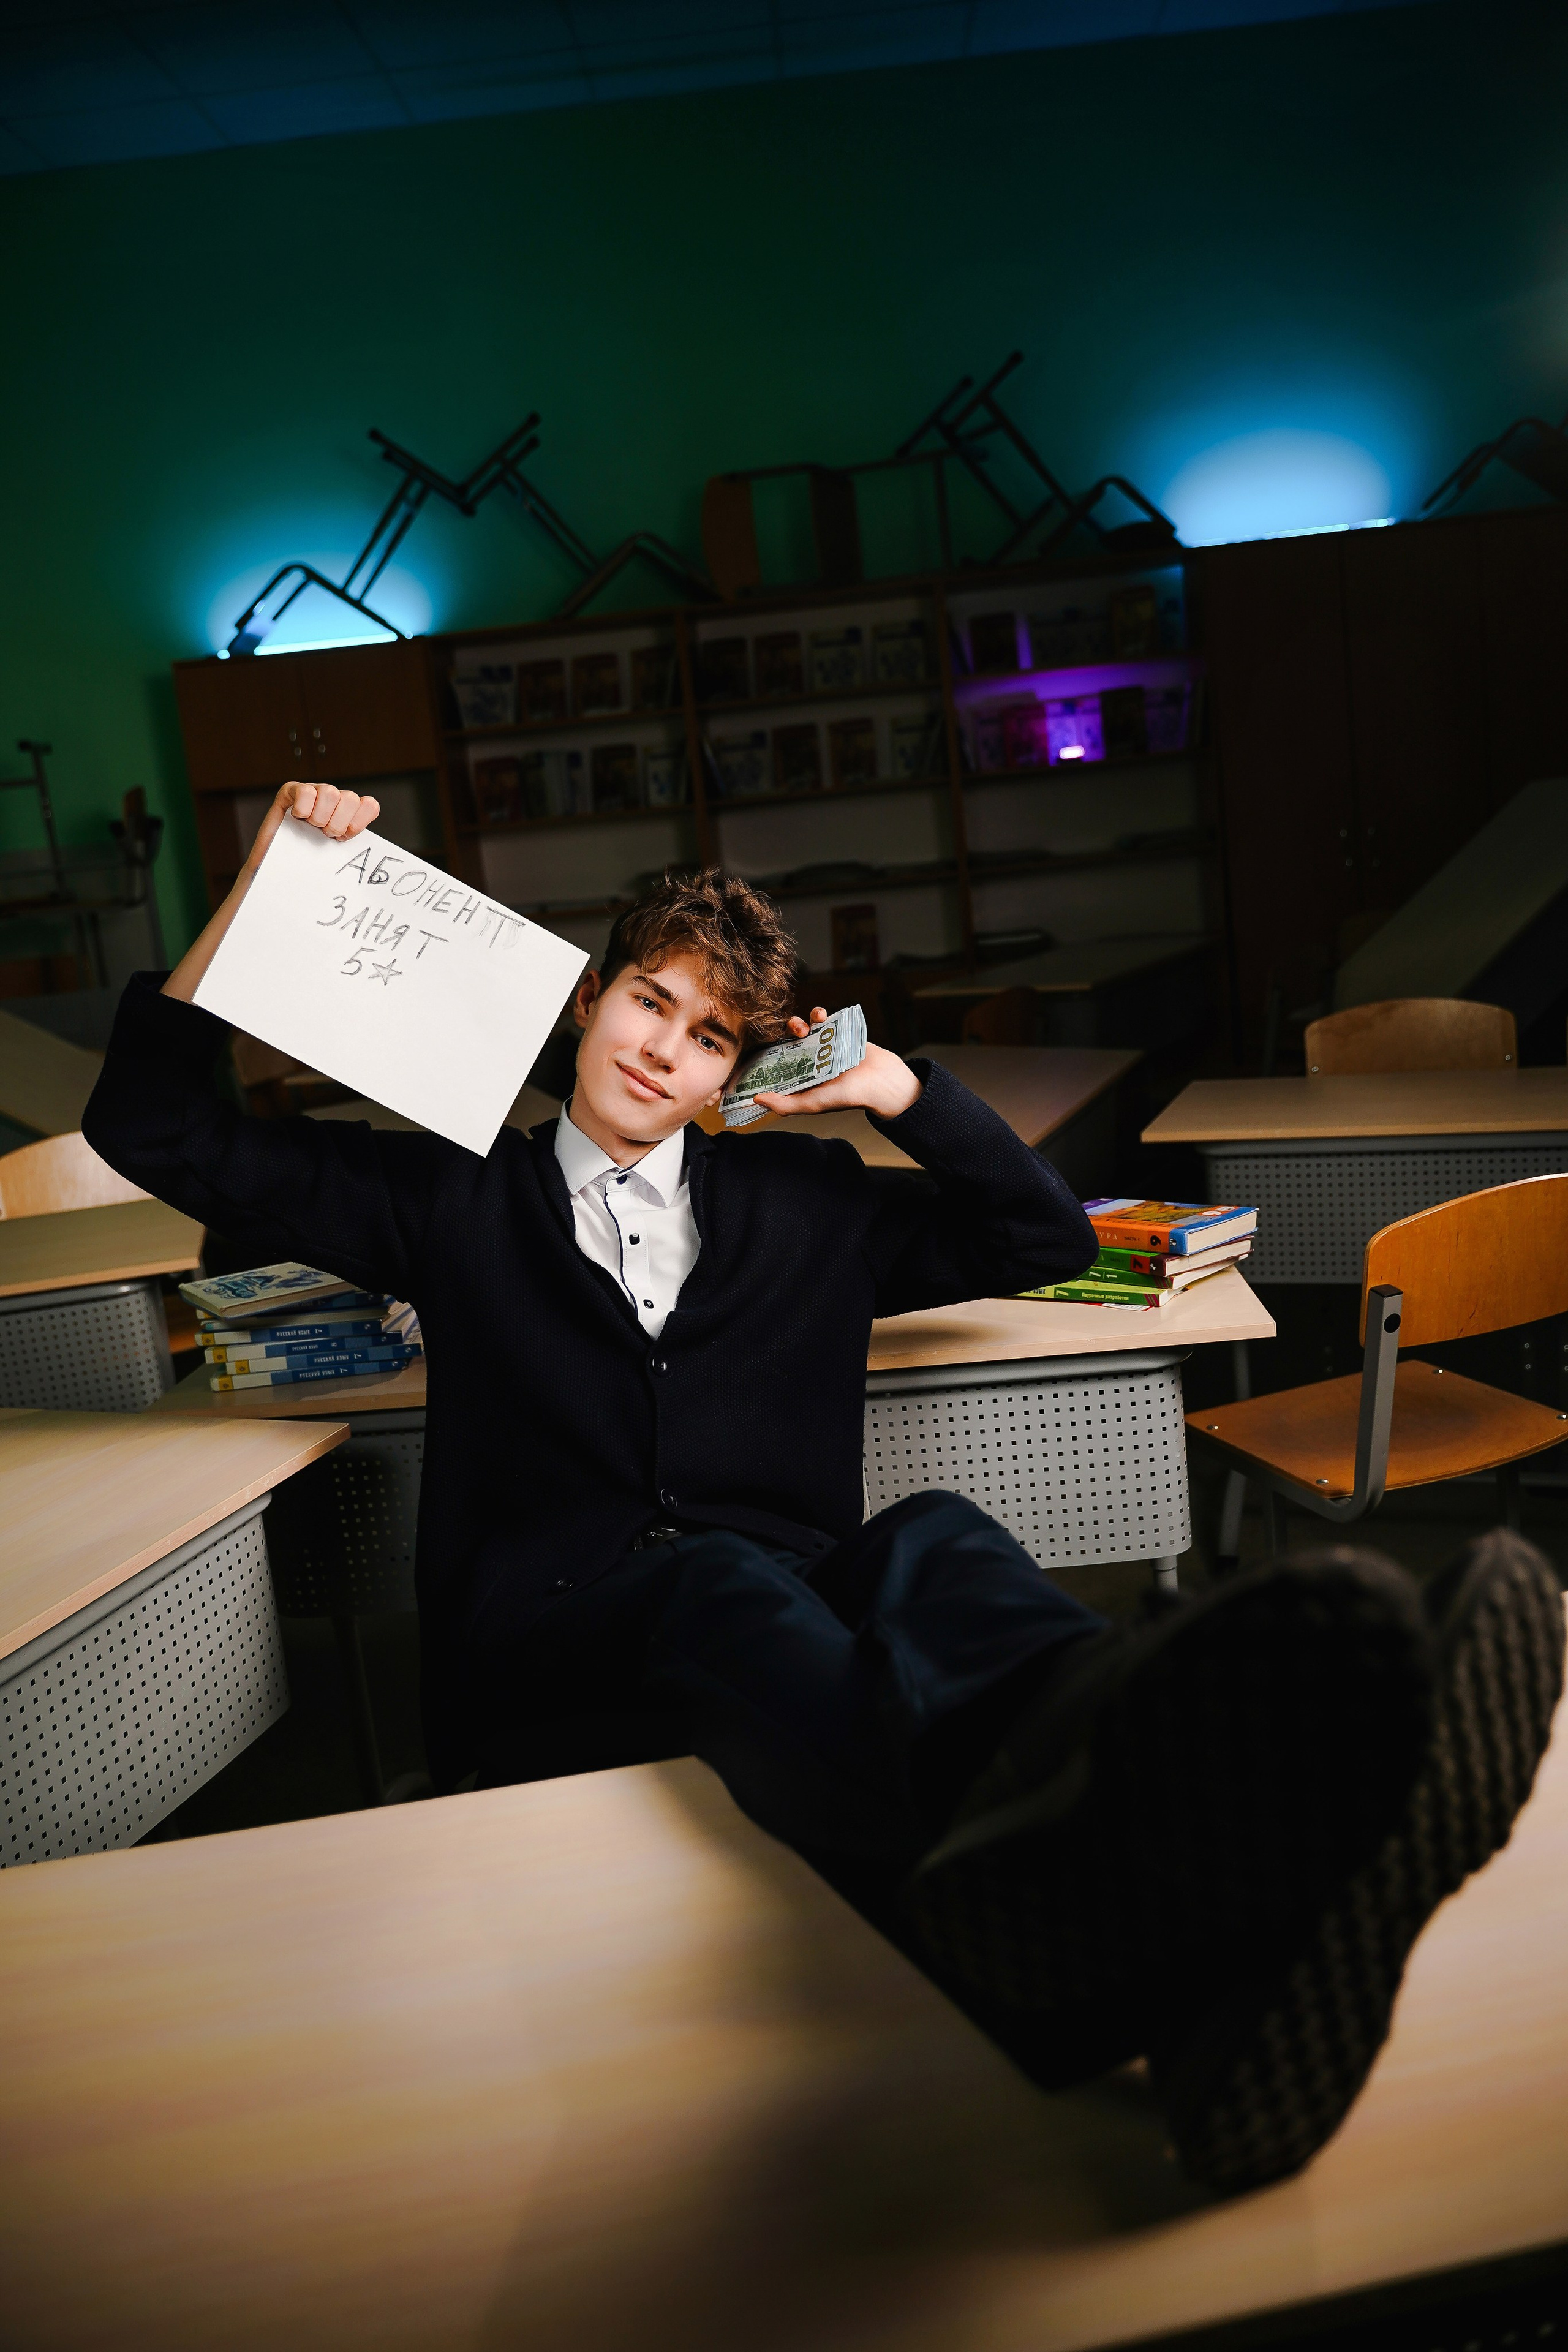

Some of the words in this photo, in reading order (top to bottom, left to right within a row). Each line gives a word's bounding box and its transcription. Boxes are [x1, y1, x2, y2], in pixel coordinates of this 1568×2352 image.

[317, 896, 449, 960] ЗАНЯТ
[816, 1027, 835, 1074] 100
[1096, 1231, 1117, 1240] УРА
